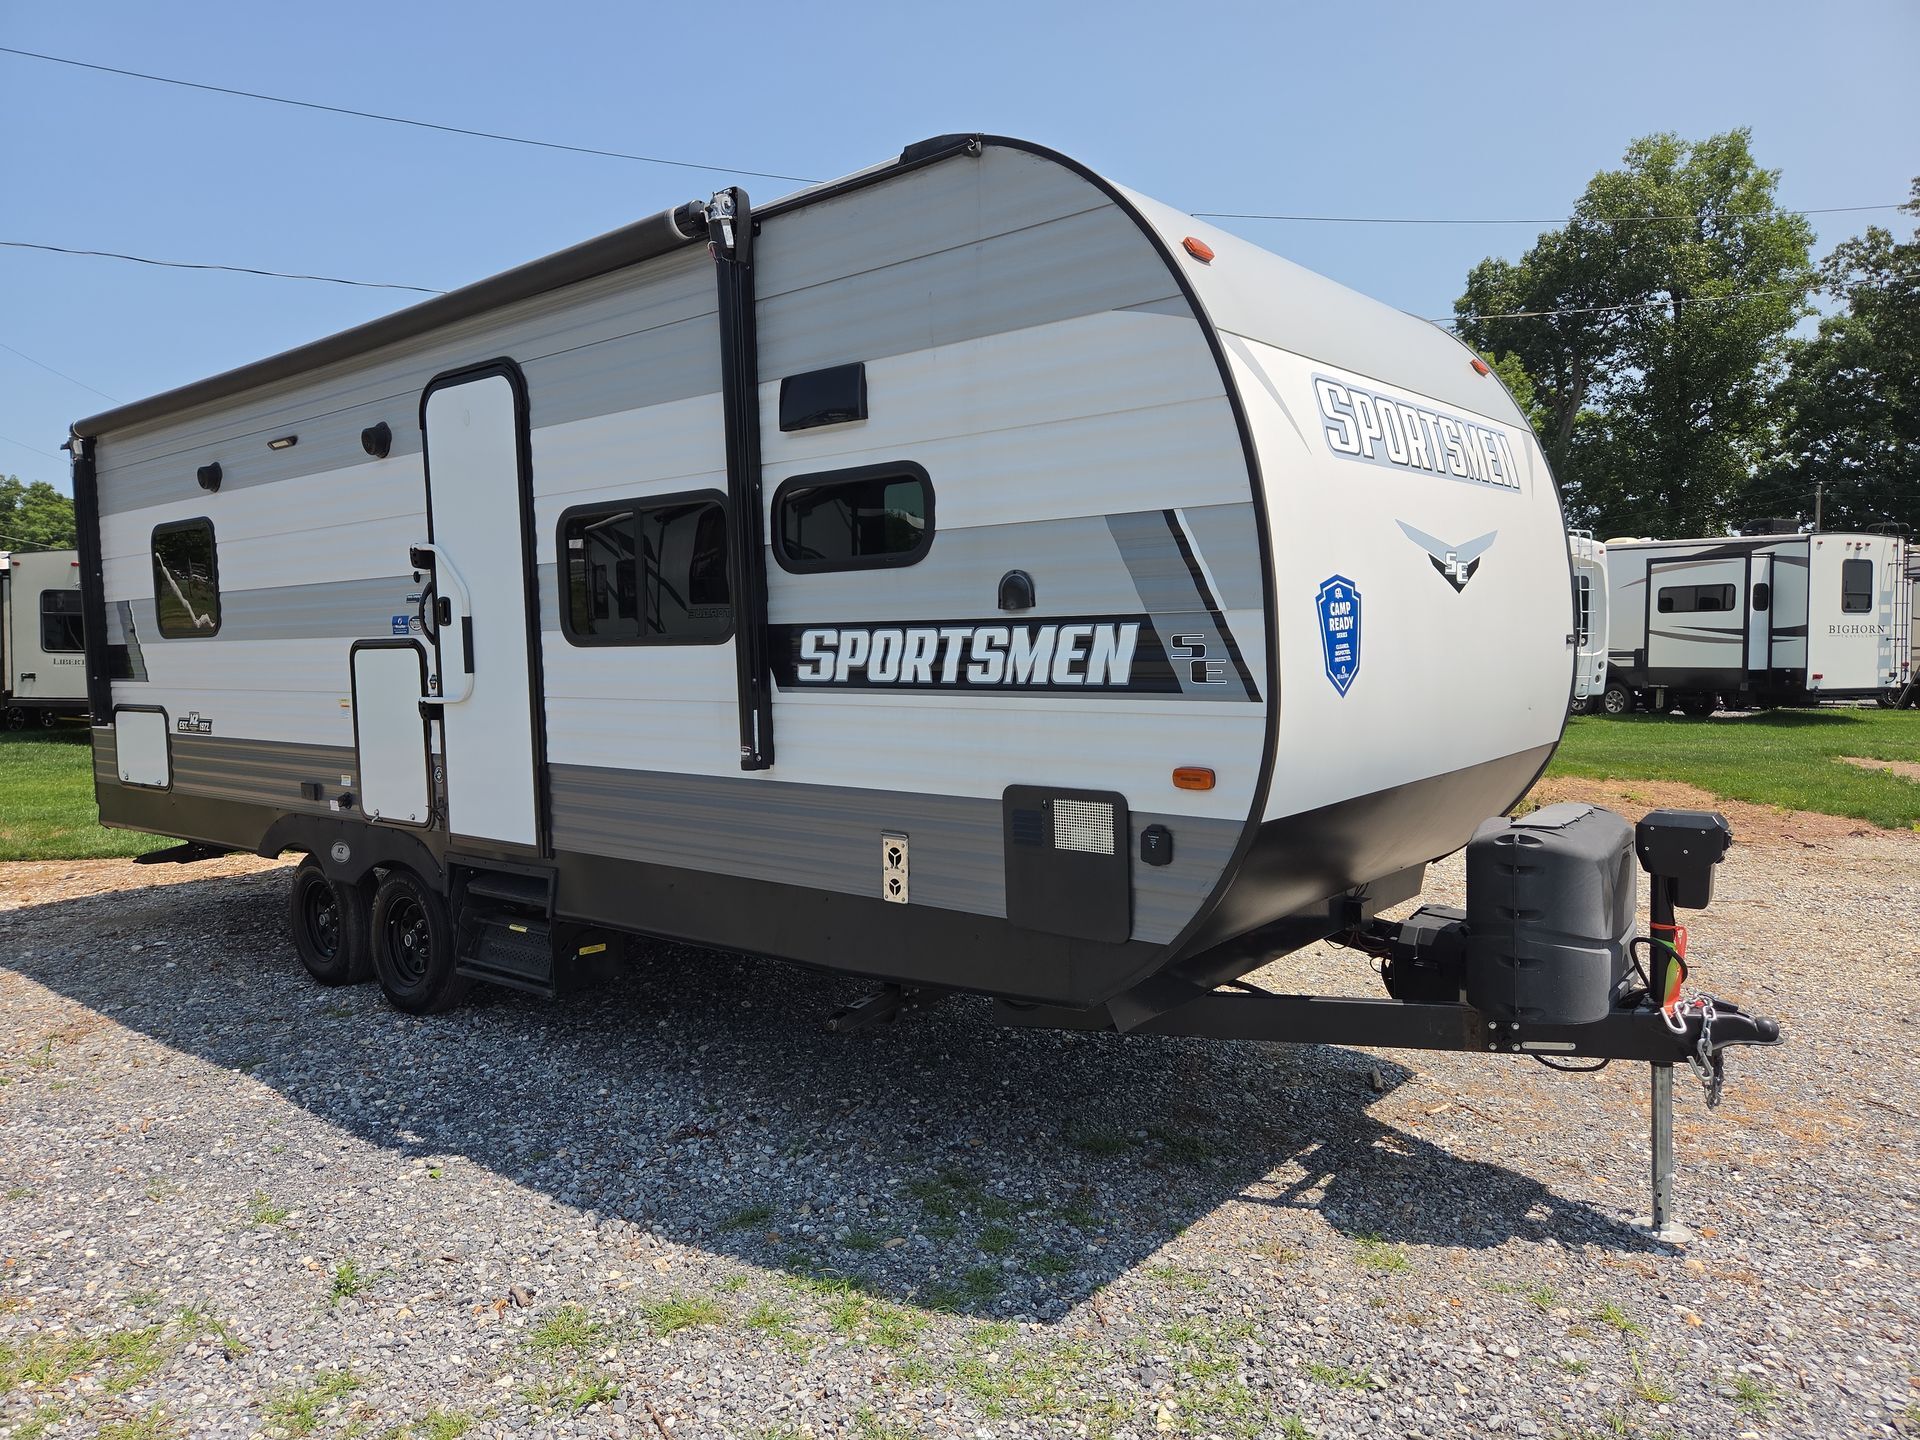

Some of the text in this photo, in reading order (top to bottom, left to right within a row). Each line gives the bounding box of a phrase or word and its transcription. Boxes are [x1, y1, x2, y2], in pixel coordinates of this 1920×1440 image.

[1314, 377, 1520, 490] SPORTSMEN
[1444, 551, 1469, 584] SE
[1330, 602, 1351, 616] CAMP
[1328, 616, 1354, 632] READY
[1828, 624, 1885, 634] BIGHORN
[797, 622, 1227, 686] SPORTSMEN SE
